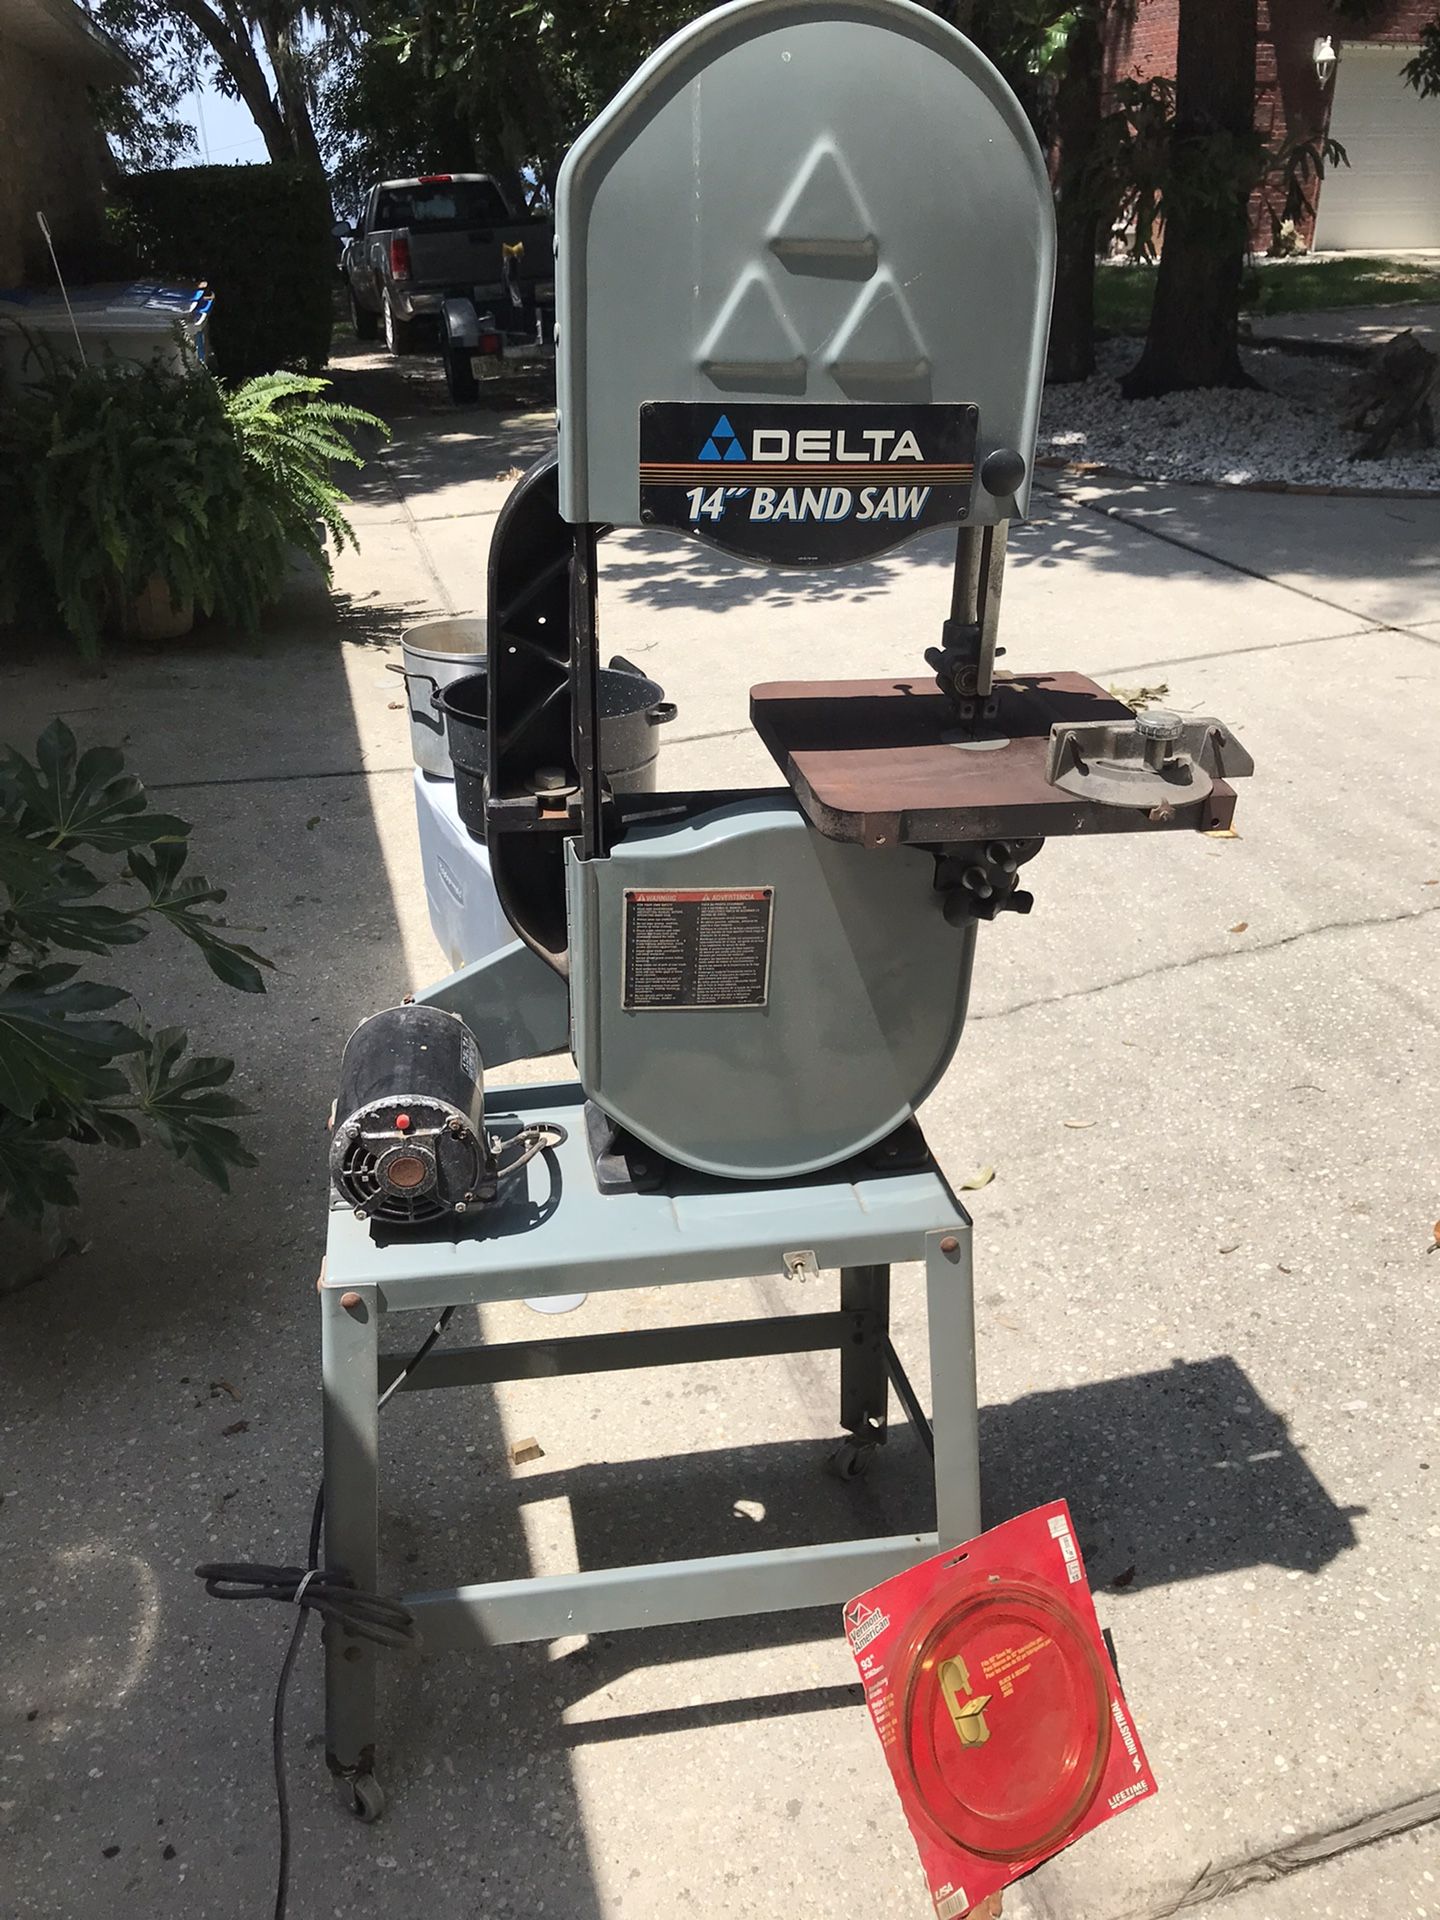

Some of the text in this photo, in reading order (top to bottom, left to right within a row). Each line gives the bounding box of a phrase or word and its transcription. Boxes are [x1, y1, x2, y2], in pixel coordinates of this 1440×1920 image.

[752, 429, 925, 462] DELTA
[749, 486, 851, 522] BAND
[855, 485, 932, 521] SAW
[645, 894, 677, 902] WARNING
[711, 893, 755, 901] ADVERTENCIA
[850, 1608, 882, 1639] Vermont
[854, 1617, 889, 1652] American
[1110, 1699, 1138, 1756] INDUSTRIAL
[1107, 1780, 1148, 1806] LIFETIME
[935, 1882, 953, 1900] USA
